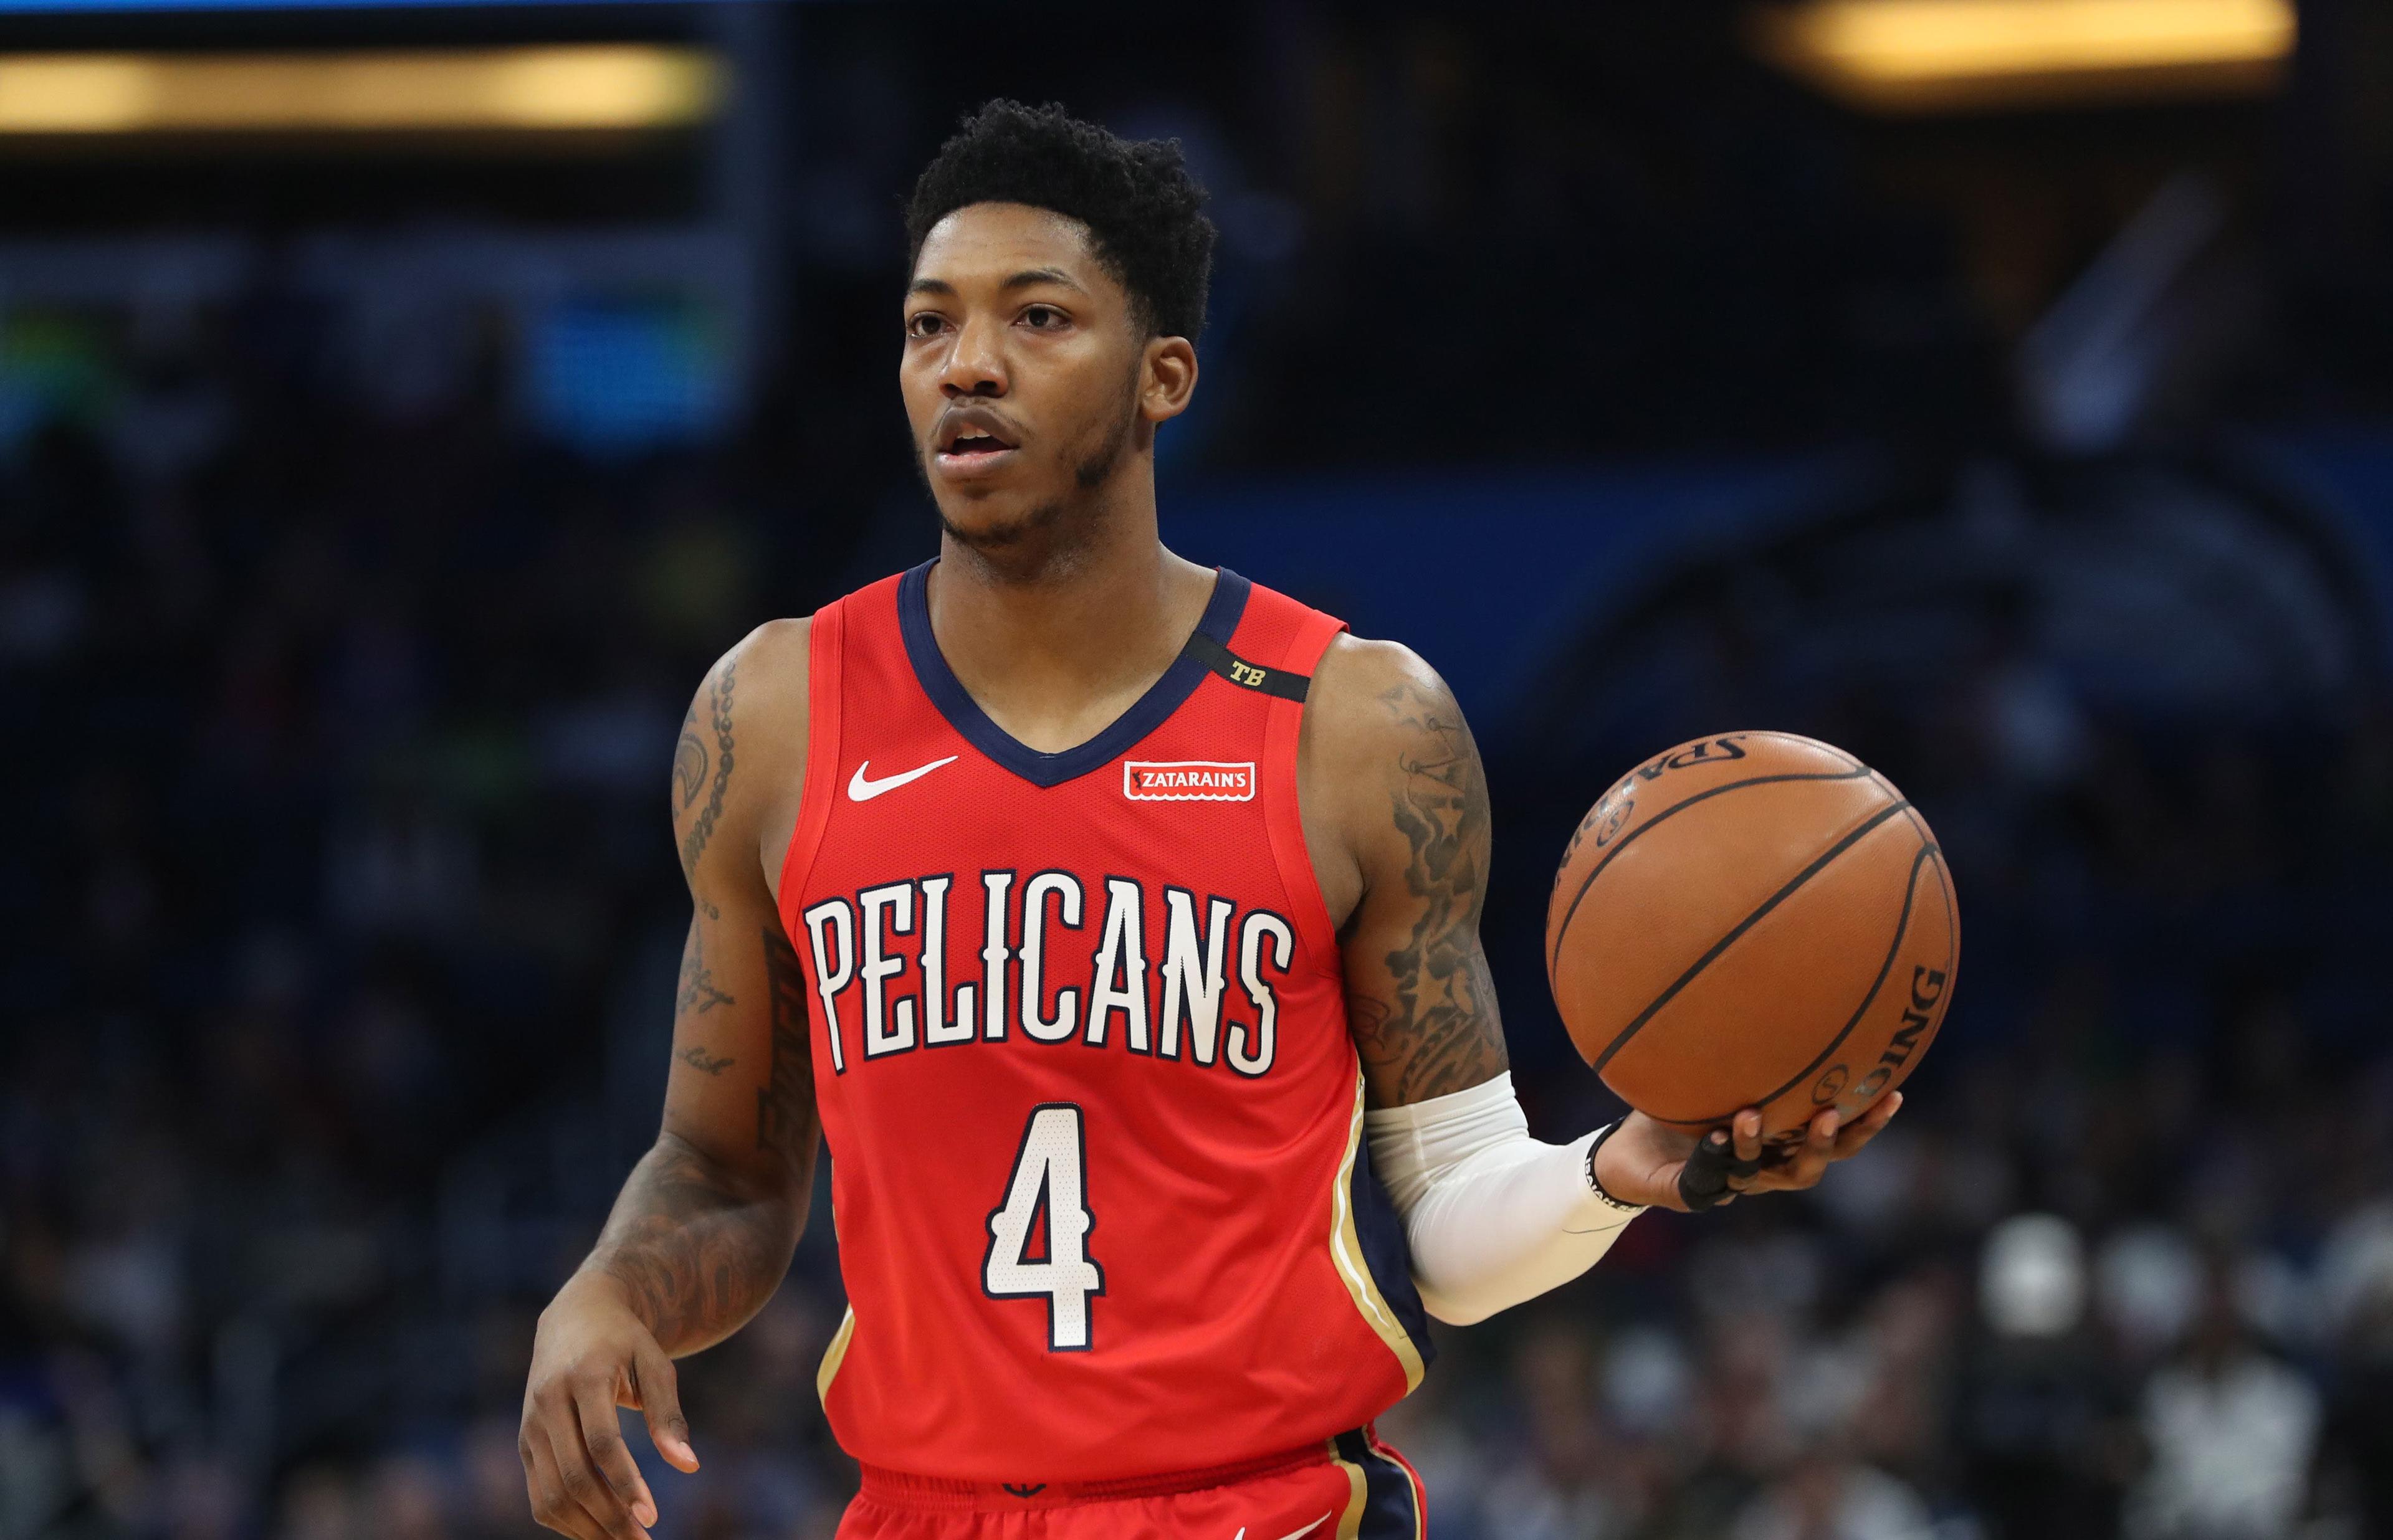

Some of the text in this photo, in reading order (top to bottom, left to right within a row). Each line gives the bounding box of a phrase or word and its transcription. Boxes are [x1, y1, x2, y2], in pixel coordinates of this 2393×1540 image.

[1230, 660, 1266, 687] TB
[1142, 772, 1246, 788] ZATARAIN'S
[802, 870, 1296, 1079] PELICANS
[981, 1101, 1106, 1352] 4
